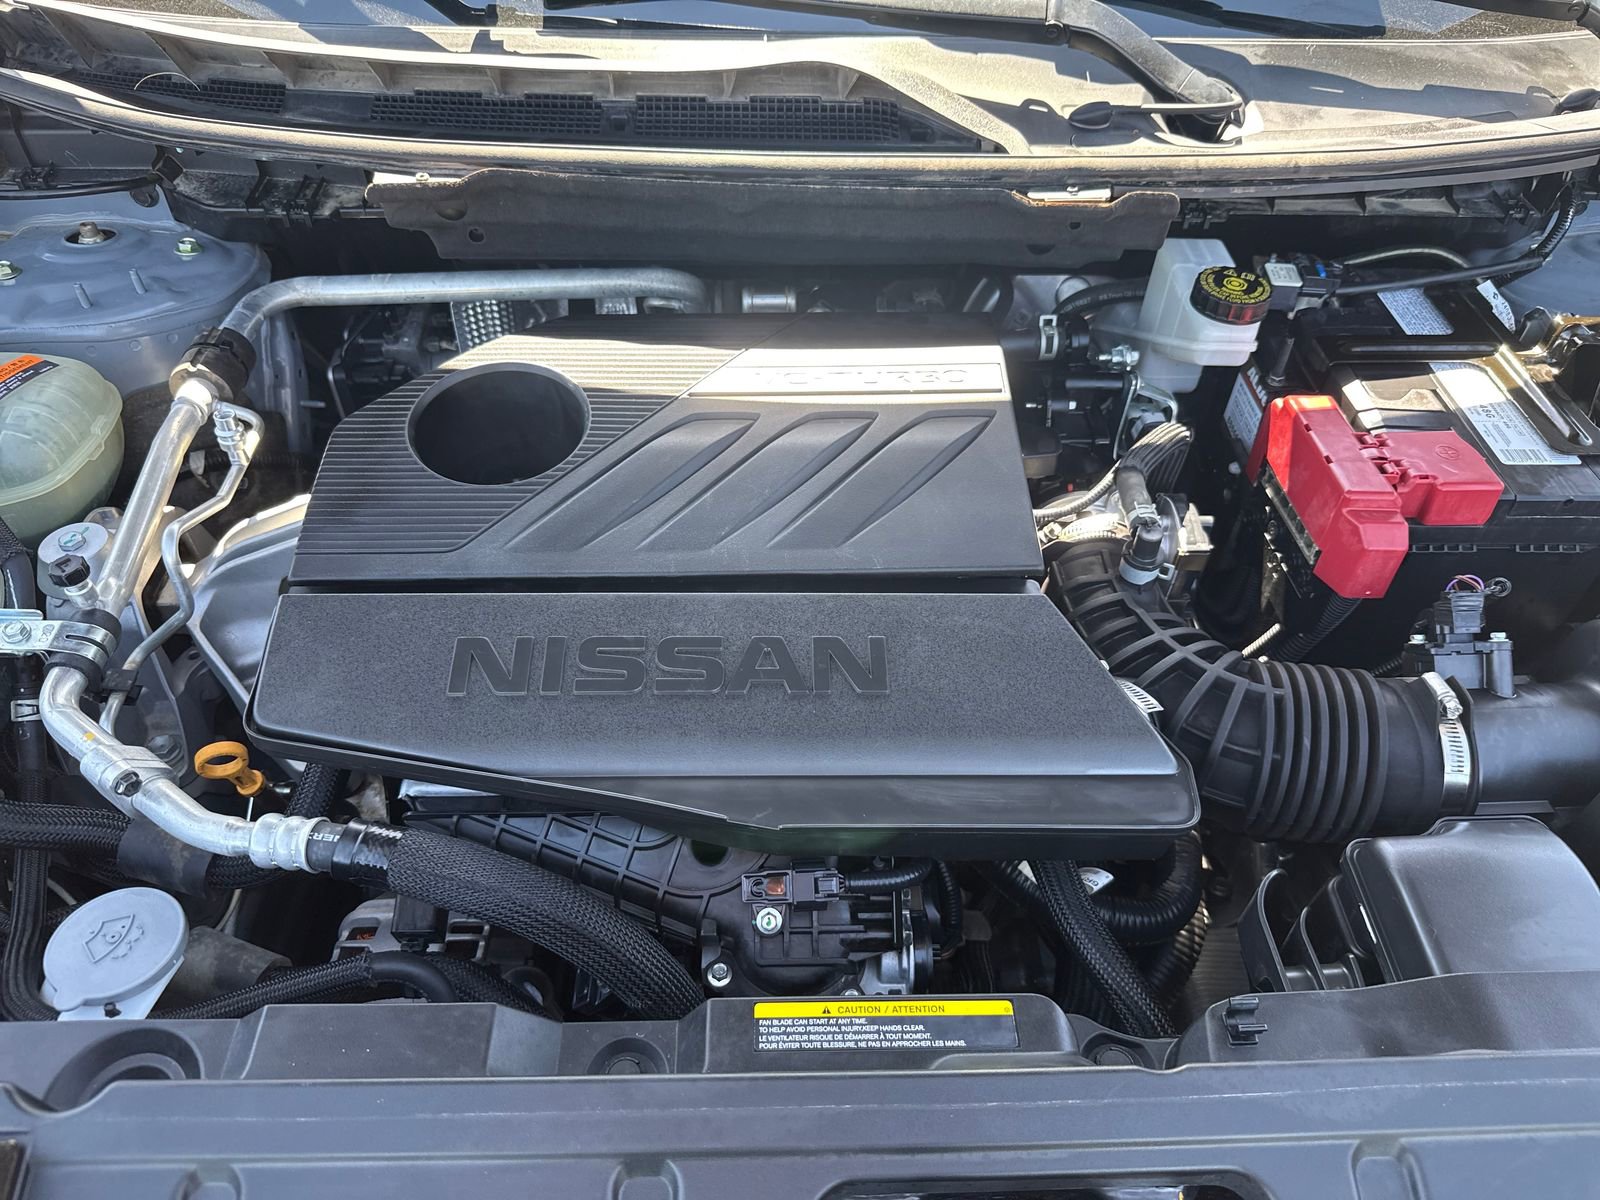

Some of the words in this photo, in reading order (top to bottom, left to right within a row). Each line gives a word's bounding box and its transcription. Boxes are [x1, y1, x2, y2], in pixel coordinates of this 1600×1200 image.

[754, 368, 968, 385] C-TURBO
[446, 635, 889, 696] NISSAN
[837, 1005, 881, 1014] CAUTION
[892, 1004, 945, 1013] ATTENTION
[759, 1018, 772, 1026] FAN
[759, 1034, 767, 1042] LE
[844, 1032, 879, 1040] DÉMARRER
[880, 1031, 886, 1040] À
[902, 1032, 932, 1040] MOMENT.
[779, 1041, 800, 1049] ÉVITER
